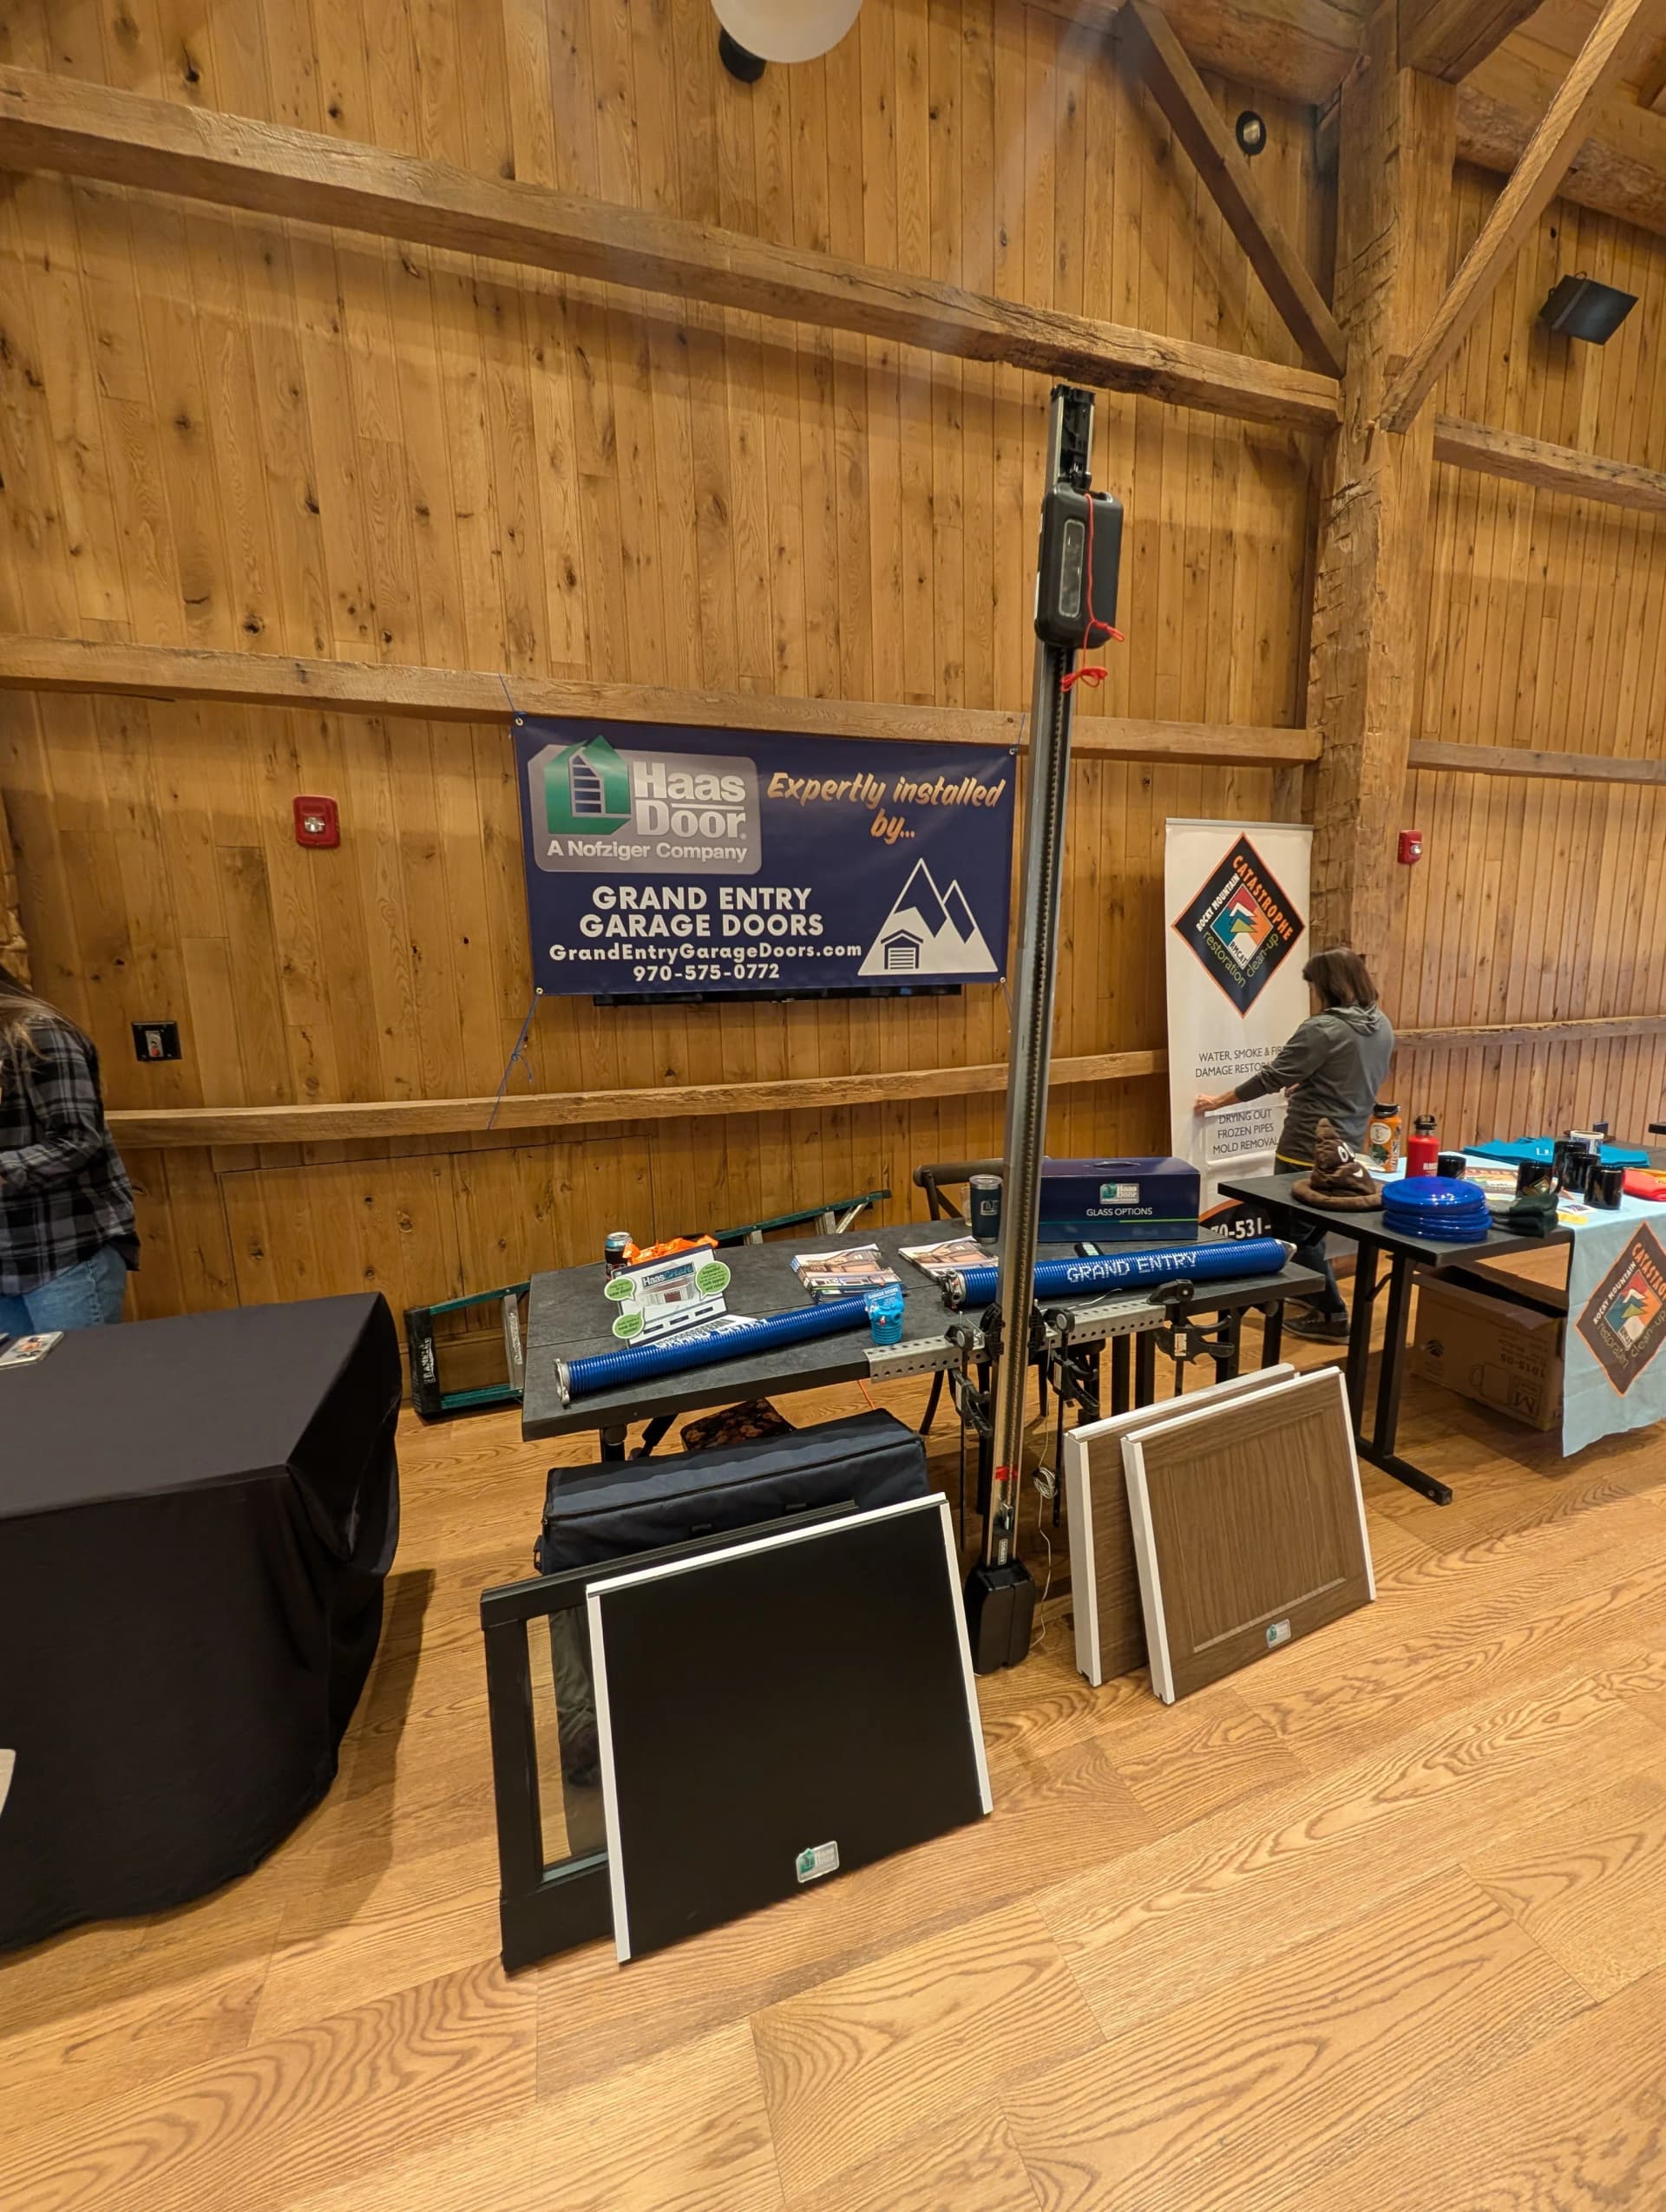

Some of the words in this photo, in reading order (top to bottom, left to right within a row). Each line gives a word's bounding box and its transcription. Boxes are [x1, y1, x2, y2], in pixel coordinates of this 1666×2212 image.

[633, 761, 746, 802] Haas
[766, 772, 886, 810] Expertly
[893, 776, 1007, 808] installed
[634, 799, 747, 838] Door
[870, 808, 915, 845] by...
[547, 840, 564, 857] A
[568, 841, 651, 861] Nofziger
[656, 842, 747, 863] Company
[592, 886, 707, 910] GRAND
[719, 887, 812, 910] ENTRY
[1195, 909, 1216, 933] ROCKY
[1210, 873, 1241, 911] MOUNTAIN
[1232, 854, 1294, 941] CATASTROPHE
[580, 913, 712, 938] GARAGE
[722, 913, 824, 937] DOORS
[549, 942, 862, 965] GrandEntryGarageDoors.com
[1203, 930, 1247, 988] restoration
[1229, 941, 1249, 965] RMCAT
[1246, 933, 1280, 978] clean-up
[633, 963, 779, 982] 970-575-0772
[1198, 1050, 1232, 1062] WATER,
[1234, 1047, 1263, 1059] SMOKE
[1264, 1046, 1270, 1057] &
[1271, 1045, 1282, 1056] FIR
[1195, 1065, 1233, 1078] DAMAGE
[1219, 1111, 1251, 1124] DRYING
[1253, 1109, 1272, 1120] OUT
[1217, 1126, 1251, 1139] FROZEN
[1253, 1122, 1274, 1135] PIPES
[1213, 1142, 1239, 1155] MOLD
[1240, 1136, 1278, 1150] REMOVAL
[1114, 1207, 1153, 1215] OPTIONS
[1066, 1260, 1131, 1283] GRAND
[1137, 1251, 1197, 1273] ENTRY
[1631, 1242, 1666, 1301] CATASTRO
[1607, 1261, 1636, 1301] MOUNTAIN
